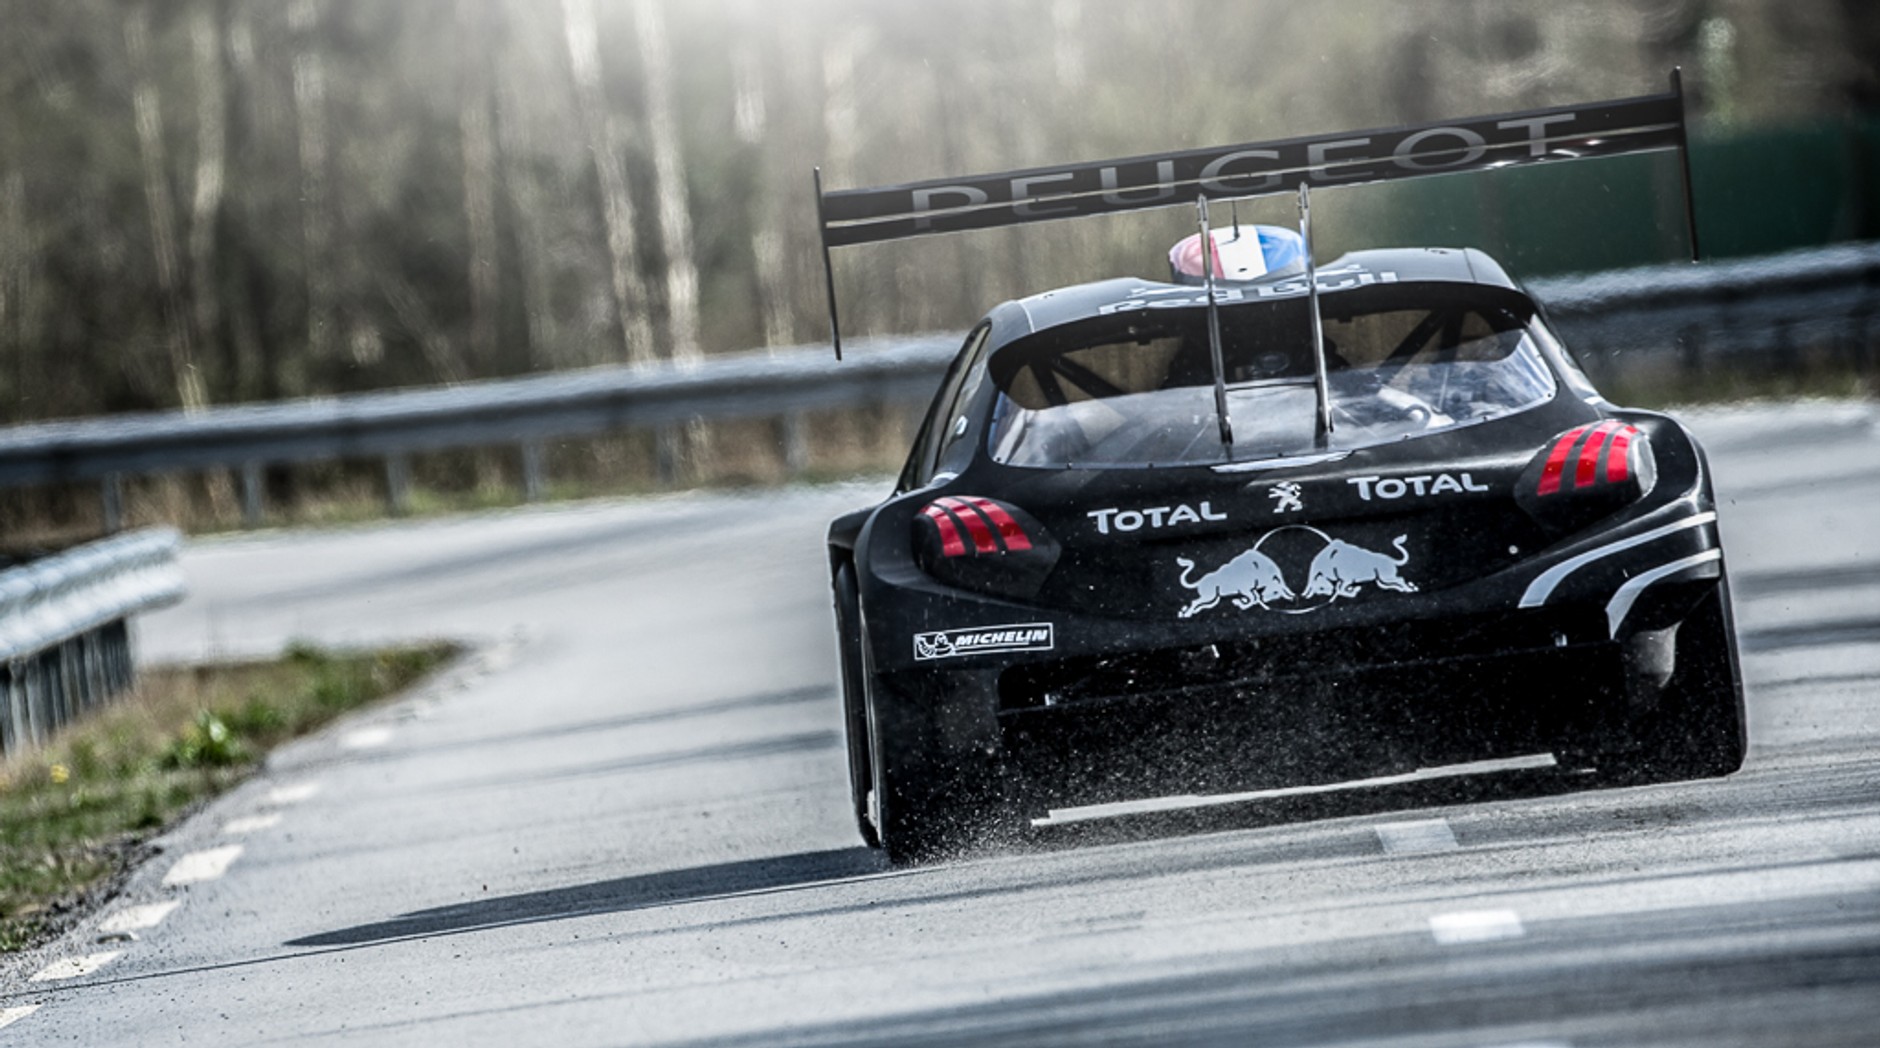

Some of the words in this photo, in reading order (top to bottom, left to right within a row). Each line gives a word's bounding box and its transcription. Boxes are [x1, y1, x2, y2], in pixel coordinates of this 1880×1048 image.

[911, 112, 1577, 229] PEUGEOT
[1346, 473, 1489, 501] TOTAL
[1087, 501, 1228, 534] TOTAL
[954, 629, 1049, 647] MICHELIN
